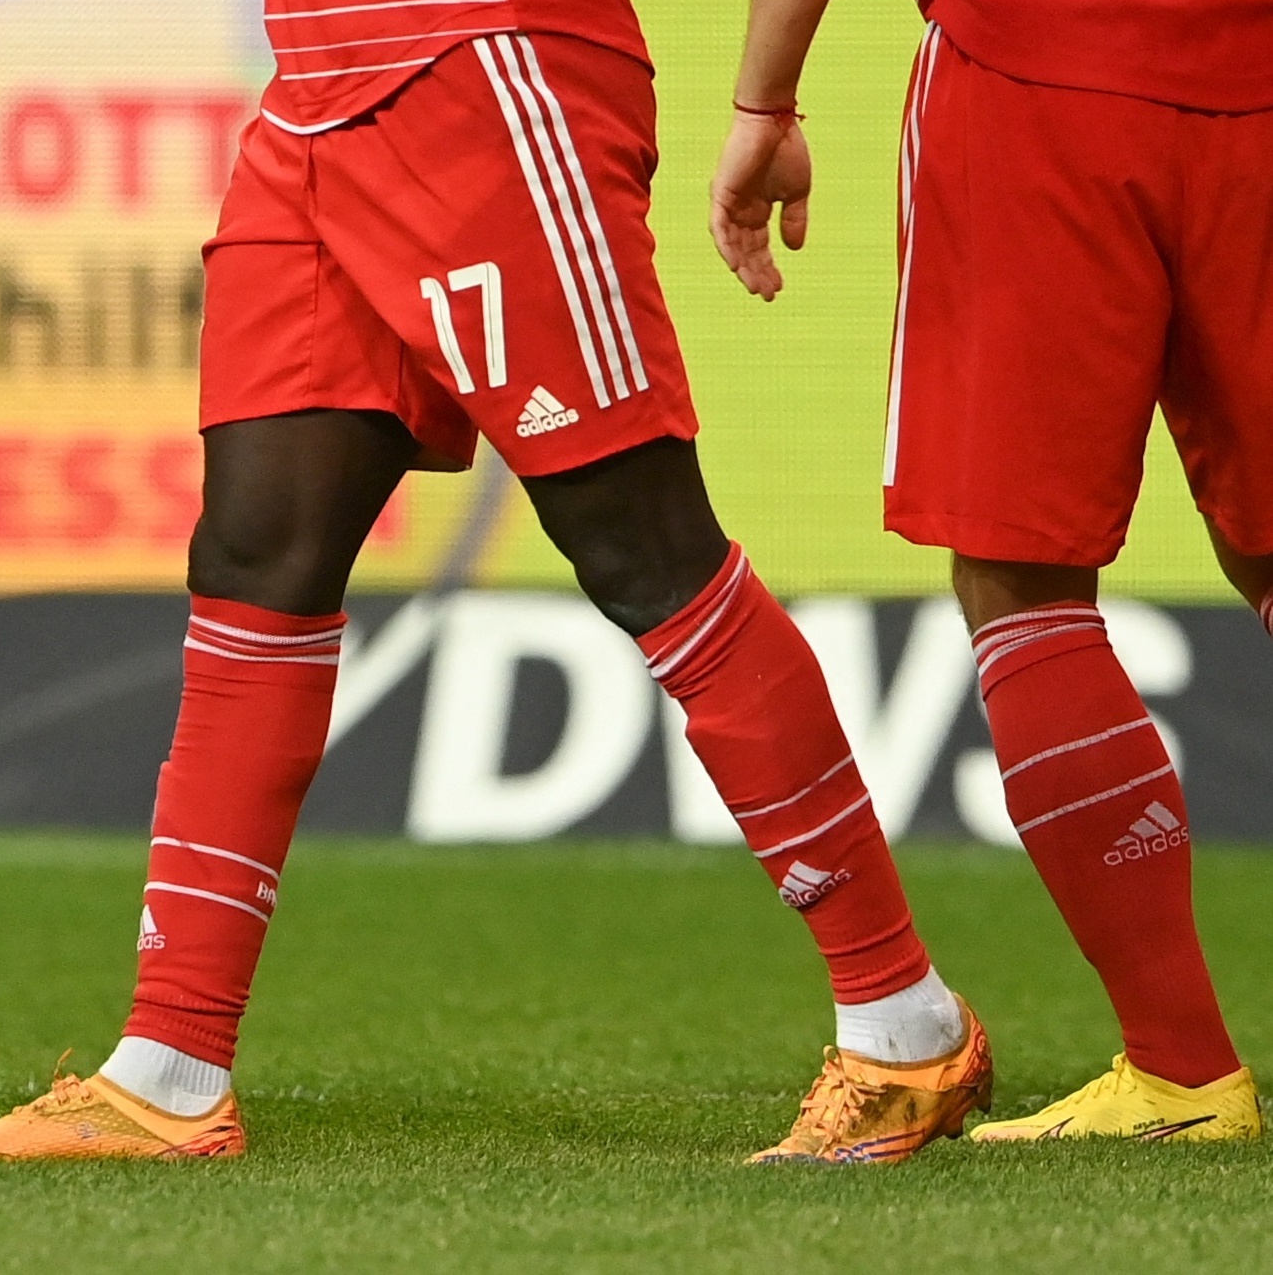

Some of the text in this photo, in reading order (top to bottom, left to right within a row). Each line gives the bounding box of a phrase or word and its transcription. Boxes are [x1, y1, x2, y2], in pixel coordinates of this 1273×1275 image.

[419, 261, 507, 394] 17
[516, 408, 579, 438] adidas
[1103, 826, 1189, 866] adidas
